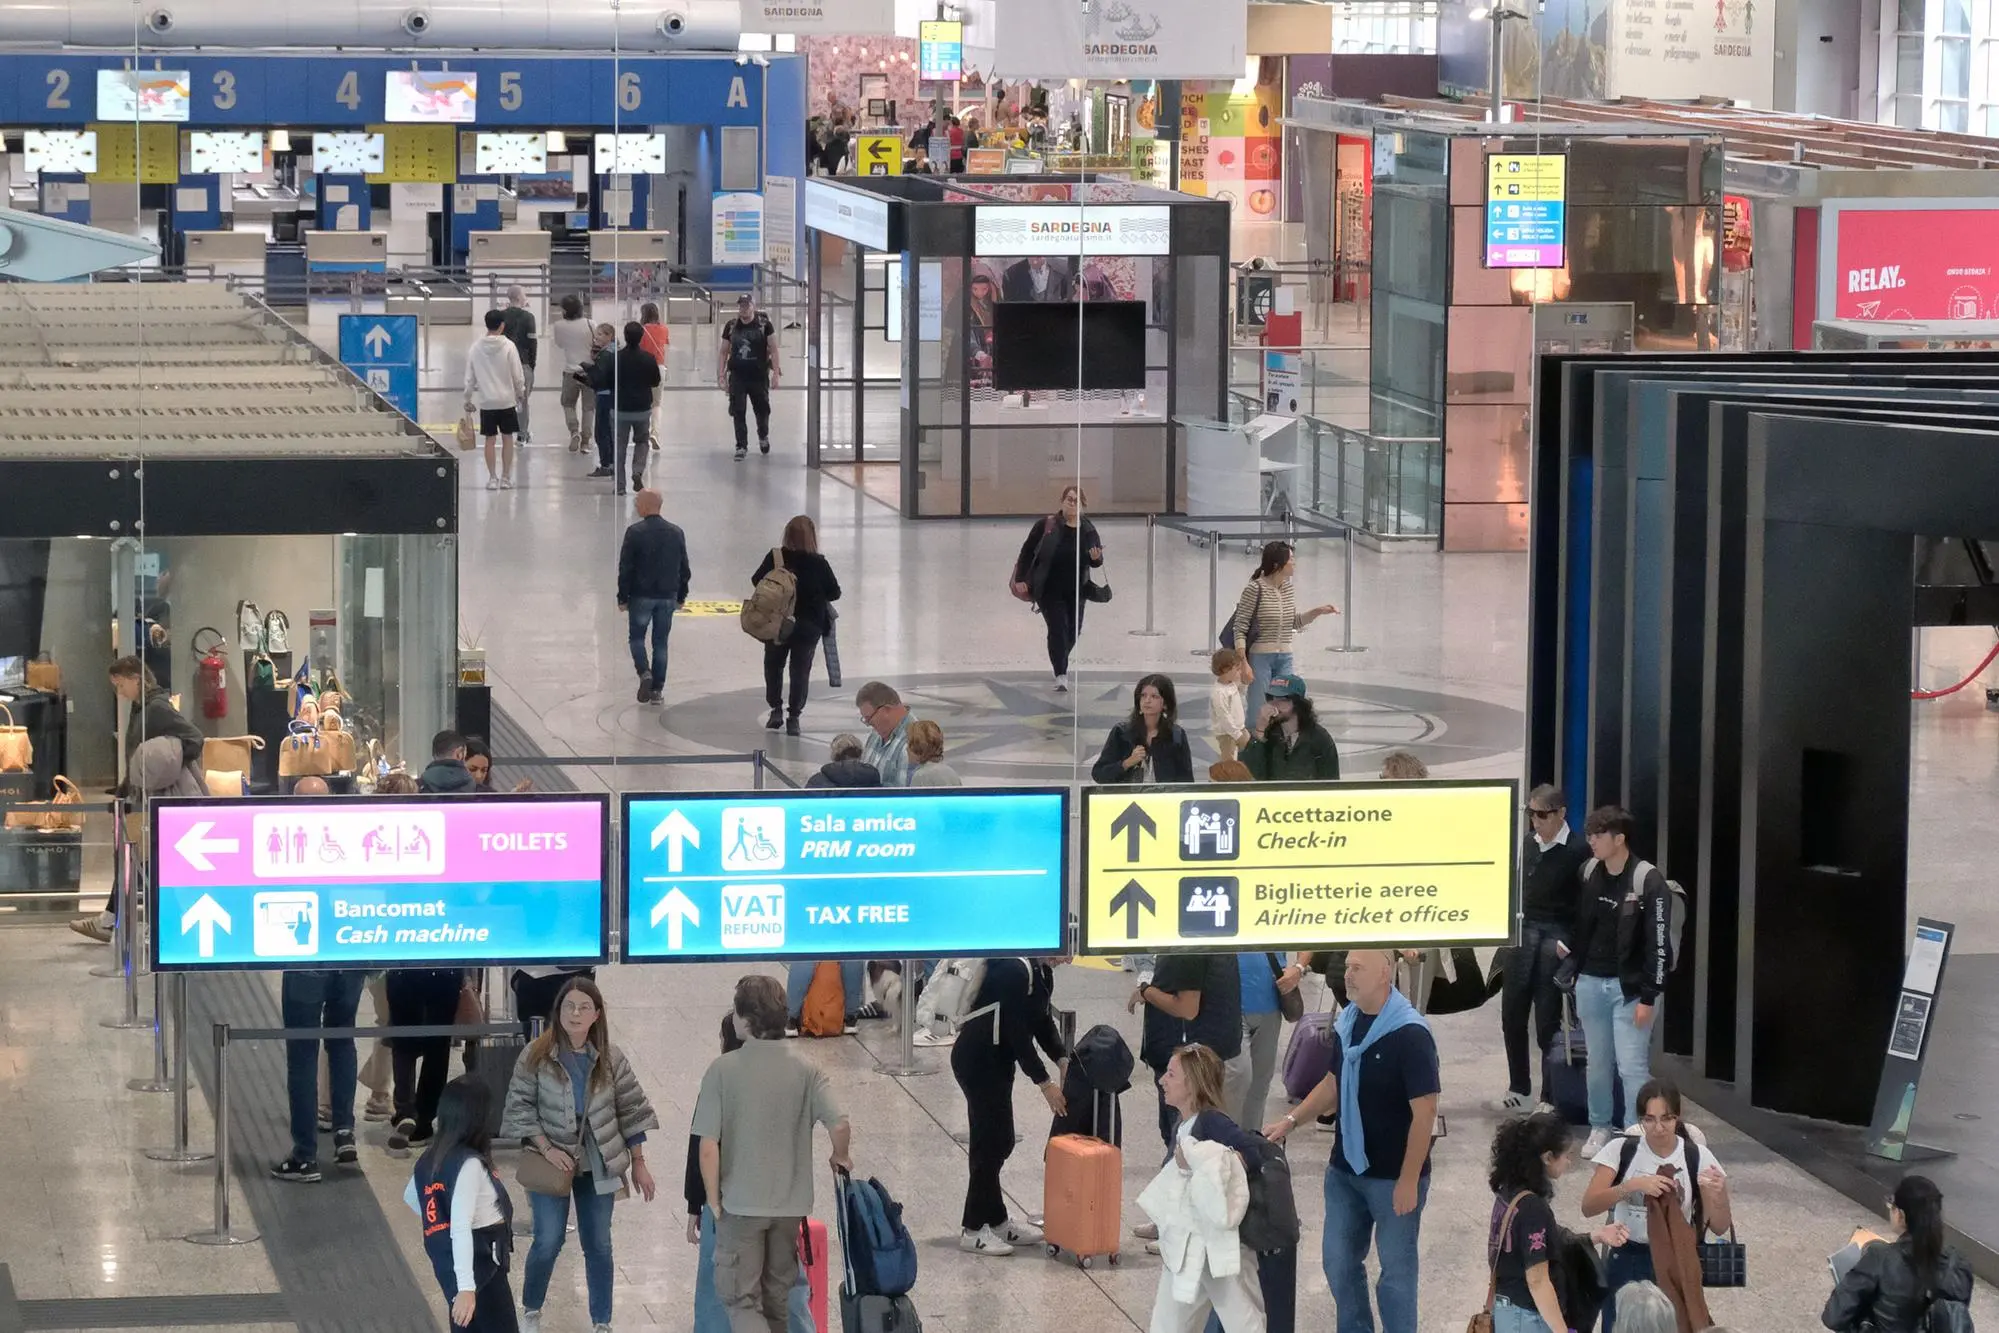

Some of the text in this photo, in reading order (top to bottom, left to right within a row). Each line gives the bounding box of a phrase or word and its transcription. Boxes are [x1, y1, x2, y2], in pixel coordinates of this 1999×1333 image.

[764, 7, 823, 16] SARDEGNA
[1084, 44, 1158, 55] SARDEGNA
[1713, 44, 1752, 57] SARDEGNA
[46, 70, 71, 109] 2
[212, 70, 237, 110] 3
[335, 71, 361, 110] 4
[499, 72, 523, 111] 5
[618, 72, 641, 111] 6
[726, 77, 748, 108] A
[1031, 222, 1112, 233] SARDEGNA
[800, 813, 917, 834] Sala amica
[1255, 806, 1393, 824] Accettazione
[479, 832, 568, 852] TOILETS
[801, 840, 916, 858] PRM room
[1256, 832, 1347, 850] Check-in
[1254, 883, 1438, 902] Biglietterie aeree
[334, 900, 446, 918] Bancomat
[723, 894, 783, 918] VAT
[805, 905, 910, 924] TAX FREE
[1254, 906, 1470, 926] Airline ticket offices
[1655, 897, 1665, 922] United
[336, 924, 489, 945] Cash machine
[723, 922, 783, 936] REFUND
[1656, 923, 1666, 947] States
